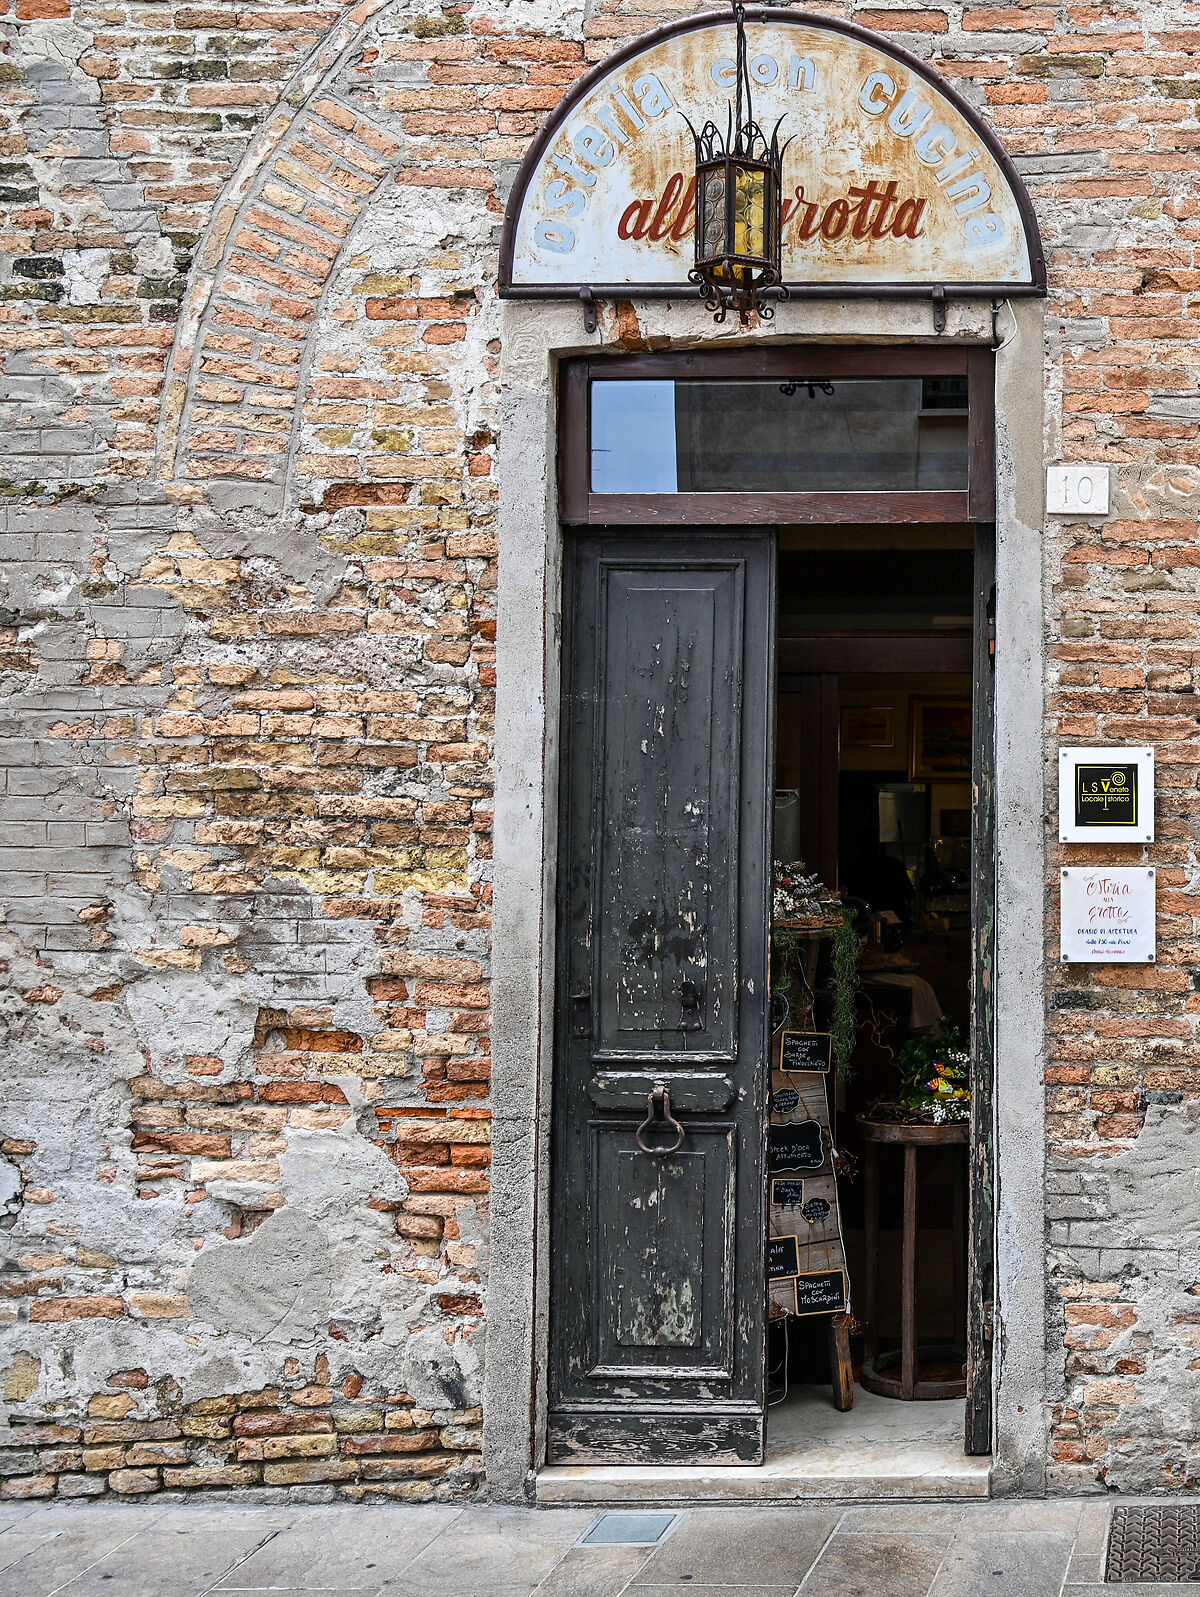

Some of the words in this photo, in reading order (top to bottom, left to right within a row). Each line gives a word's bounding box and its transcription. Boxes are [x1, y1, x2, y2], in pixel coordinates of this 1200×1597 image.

[534, 70, 675, 254] osteria
[711, 53, 817, 91] con
[859, 69, 1005, 254] cucina
[617, 172, 698, 242] all
[1062, 476, 1094, 504] 10
